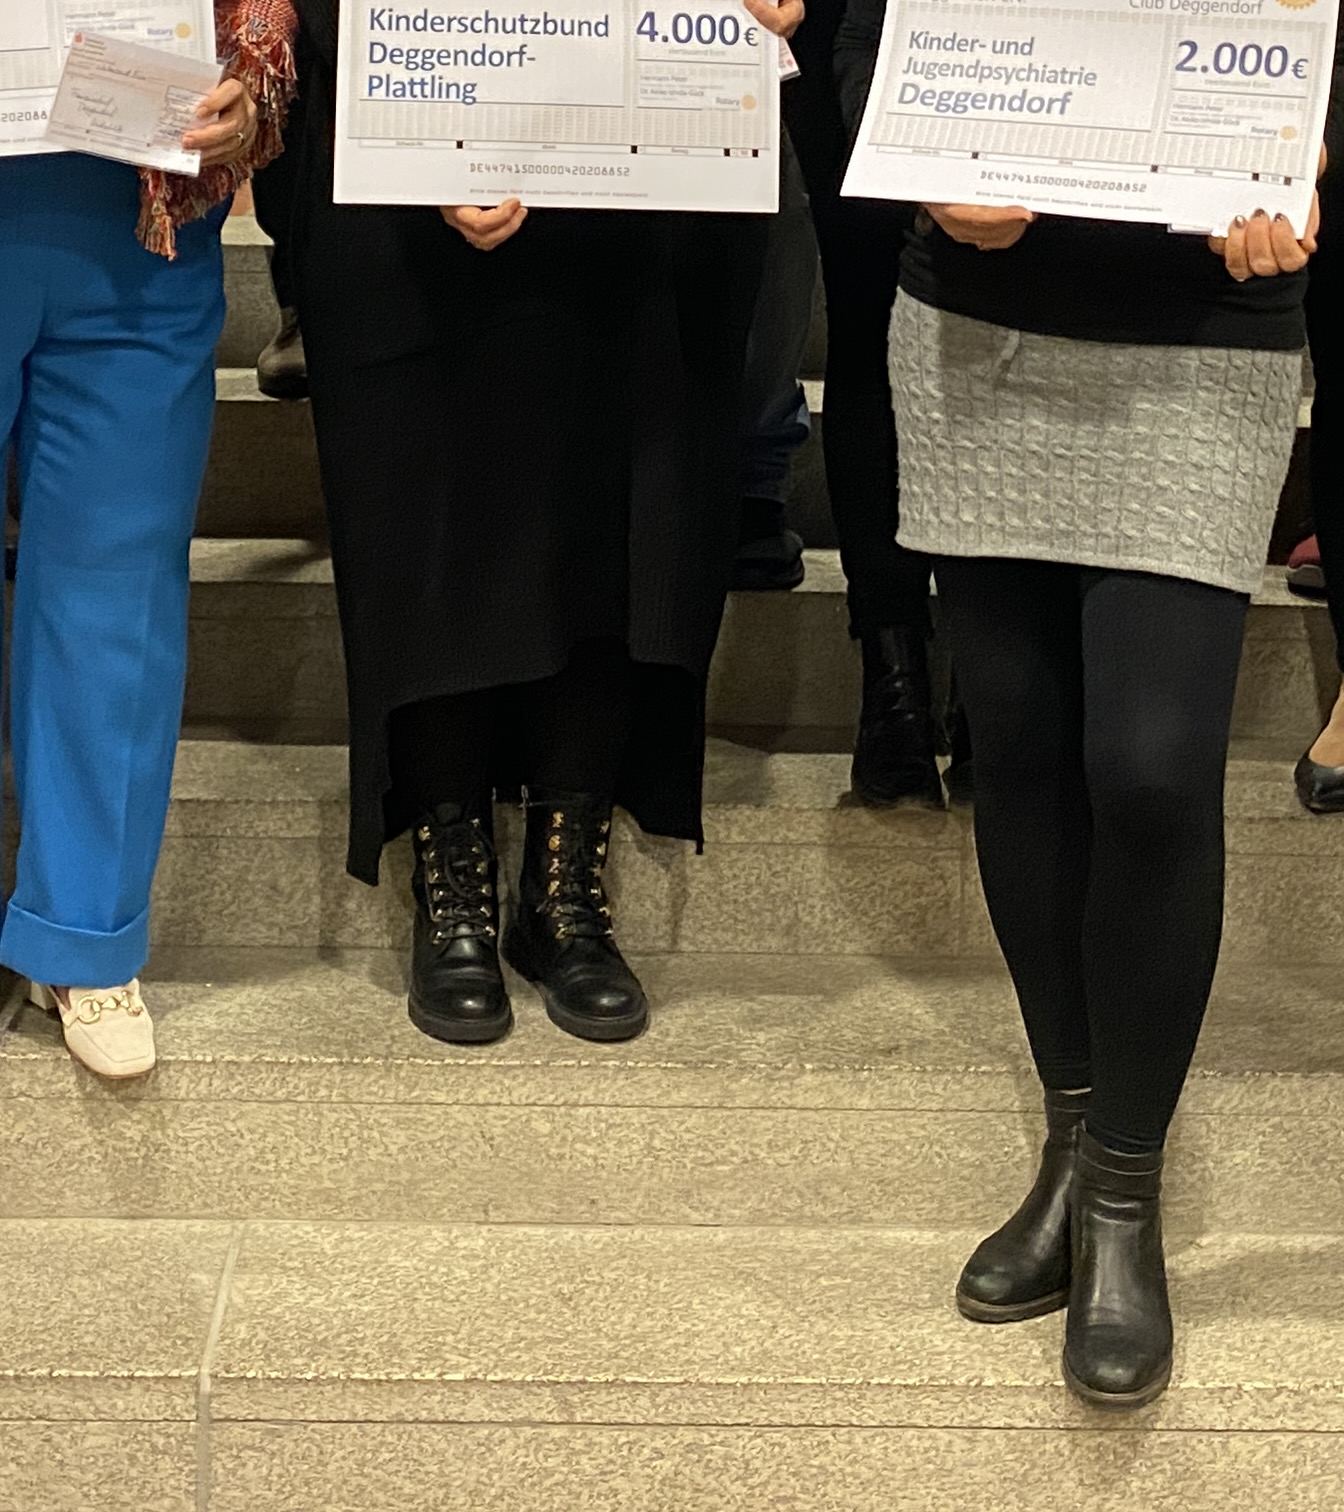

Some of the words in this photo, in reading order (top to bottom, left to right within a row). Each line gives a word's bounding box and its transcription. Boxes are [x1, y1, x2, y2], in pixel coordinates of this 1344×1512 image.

[369, 6, 610, 38] Kinderschutzbund
[368, 40, 537, 72] Deggendorf-
[908, 29, 987, 54] Kinder-
[991, 36, 1035, 57] und
[902, 56, 1098, 87] Jugendpsychiatrie
[367, 73, 478, 106] Plattling
[897, 81, 1074, 116] Deggendorf
